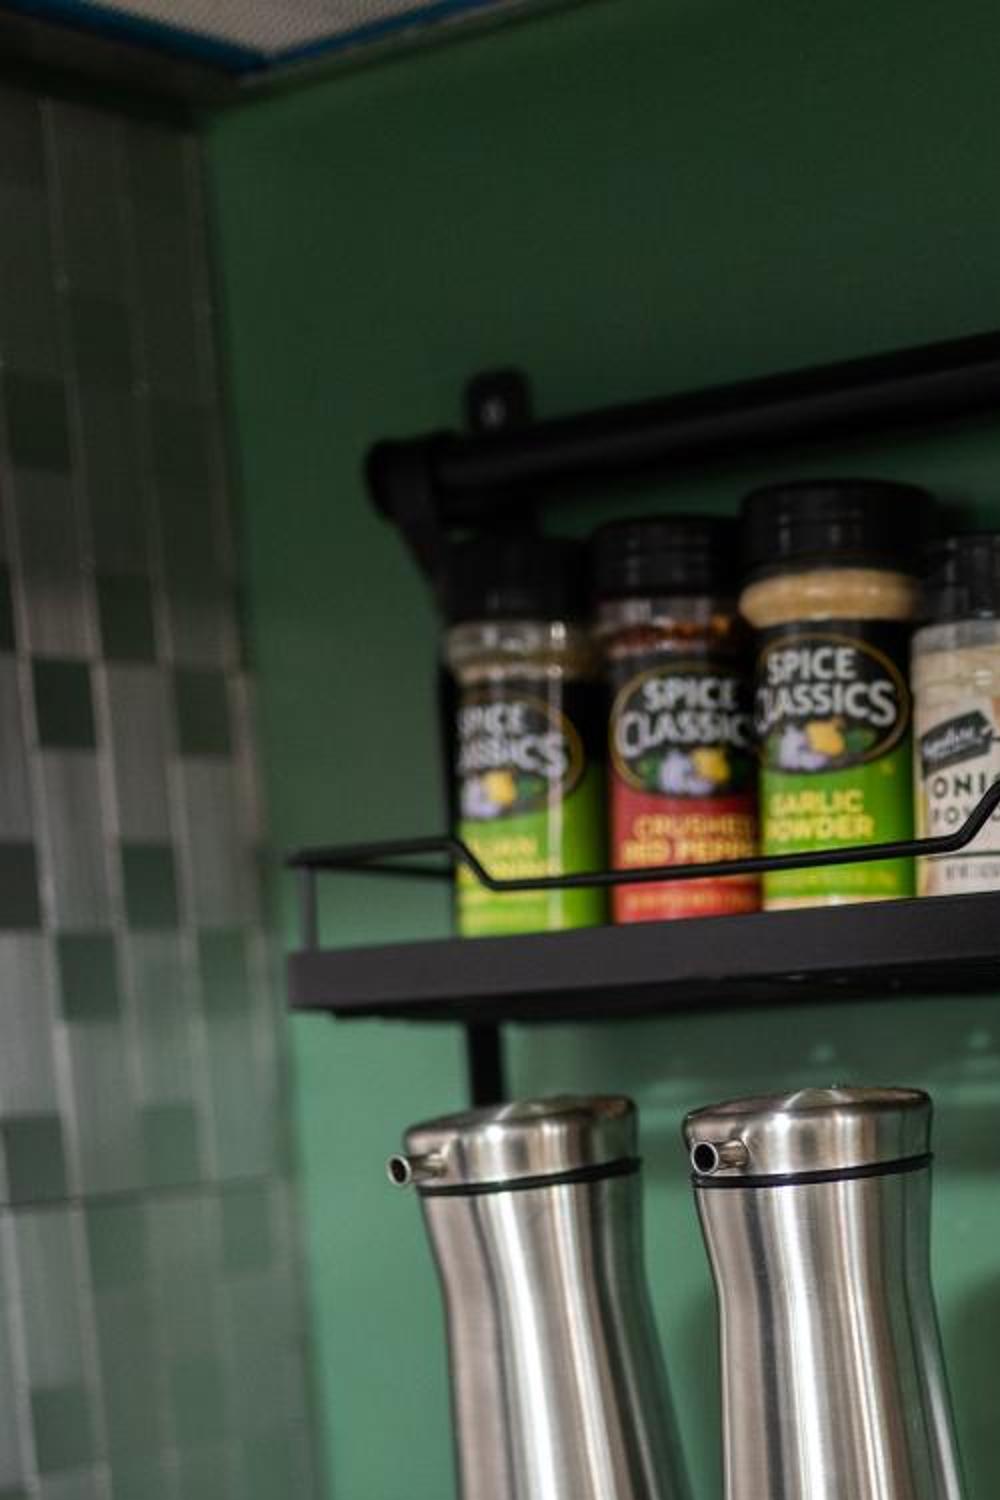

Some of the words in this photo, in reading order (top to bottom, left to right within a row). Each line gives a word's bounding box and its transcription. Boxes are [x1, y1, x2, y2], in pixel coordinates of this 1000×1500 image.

[766, 645, 857, 685] SPICE
[641, 677, 735, 712] SPICE
[616, 711, 752, 759] CLASSIC
